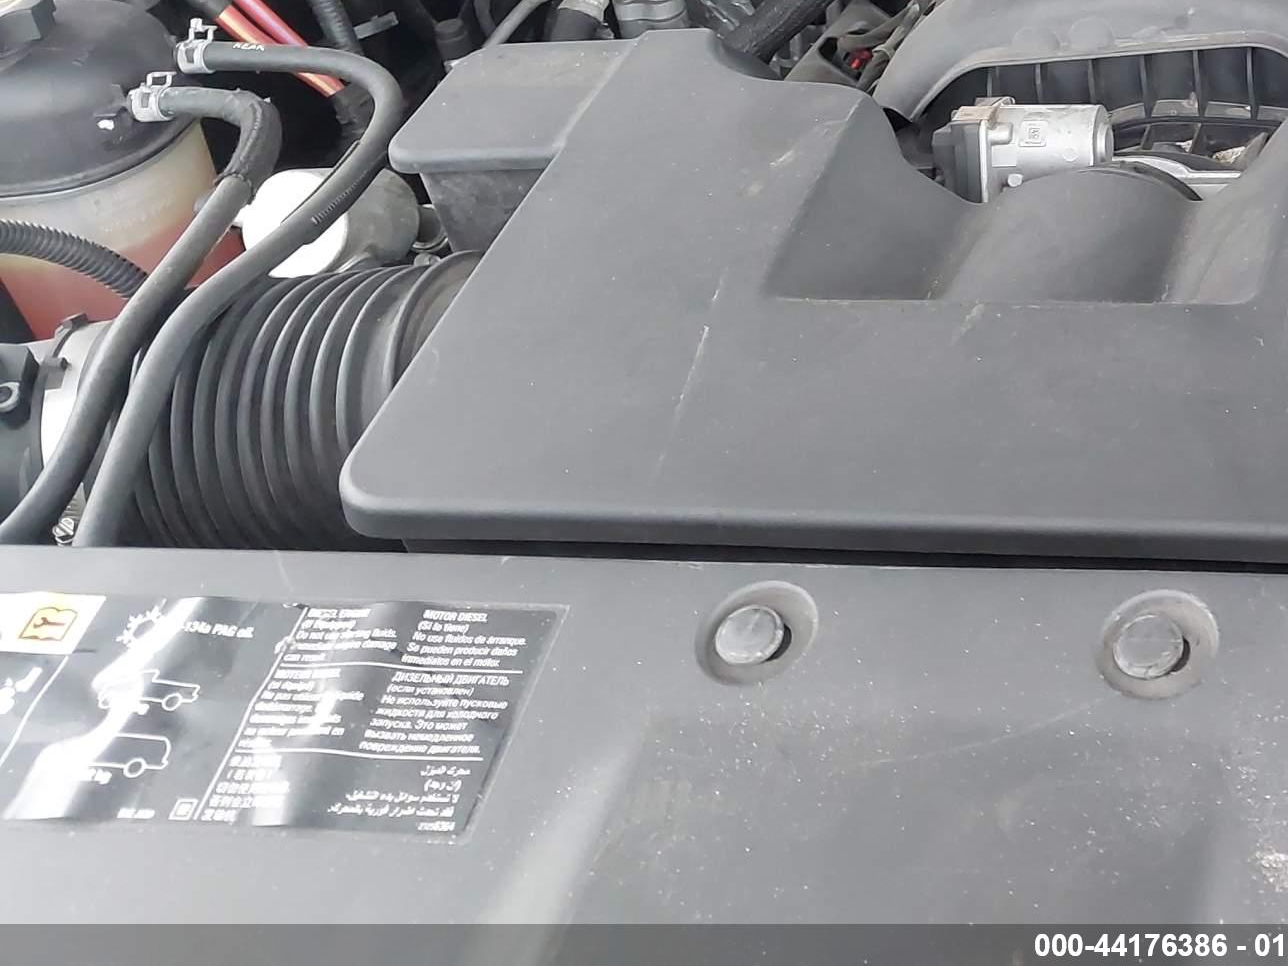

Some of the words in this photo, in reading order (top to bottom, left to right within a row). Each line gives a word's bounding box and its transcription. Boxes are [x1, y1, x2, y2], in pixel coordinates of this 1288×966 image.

[423, 610, 457, 621] MOTOR
[458, 612, 488, 622] DIESEL
[212, 623, 237, 636] PAG
[412, 632, 426, 641] No
[427, 635, 443, 643] use
[444, 634, 473, 644] fluidos
[474, 636, 486, 644] de
[361, 640, 397, 651] damage
[407, 642, 420, 652] Se
[420, 645, 454, 654] pueden
[453, 646, 490, 656] producir
[450, 658, 463, 666] en
[453, 674, 509, 686] ДВИГАТЕЛЬ
[381, 694, 396, 704] Не
[396, 697, 459, 709] используйте
[459, 699, 508, 709] пусковые
[414, 719, 434, 730] Это
